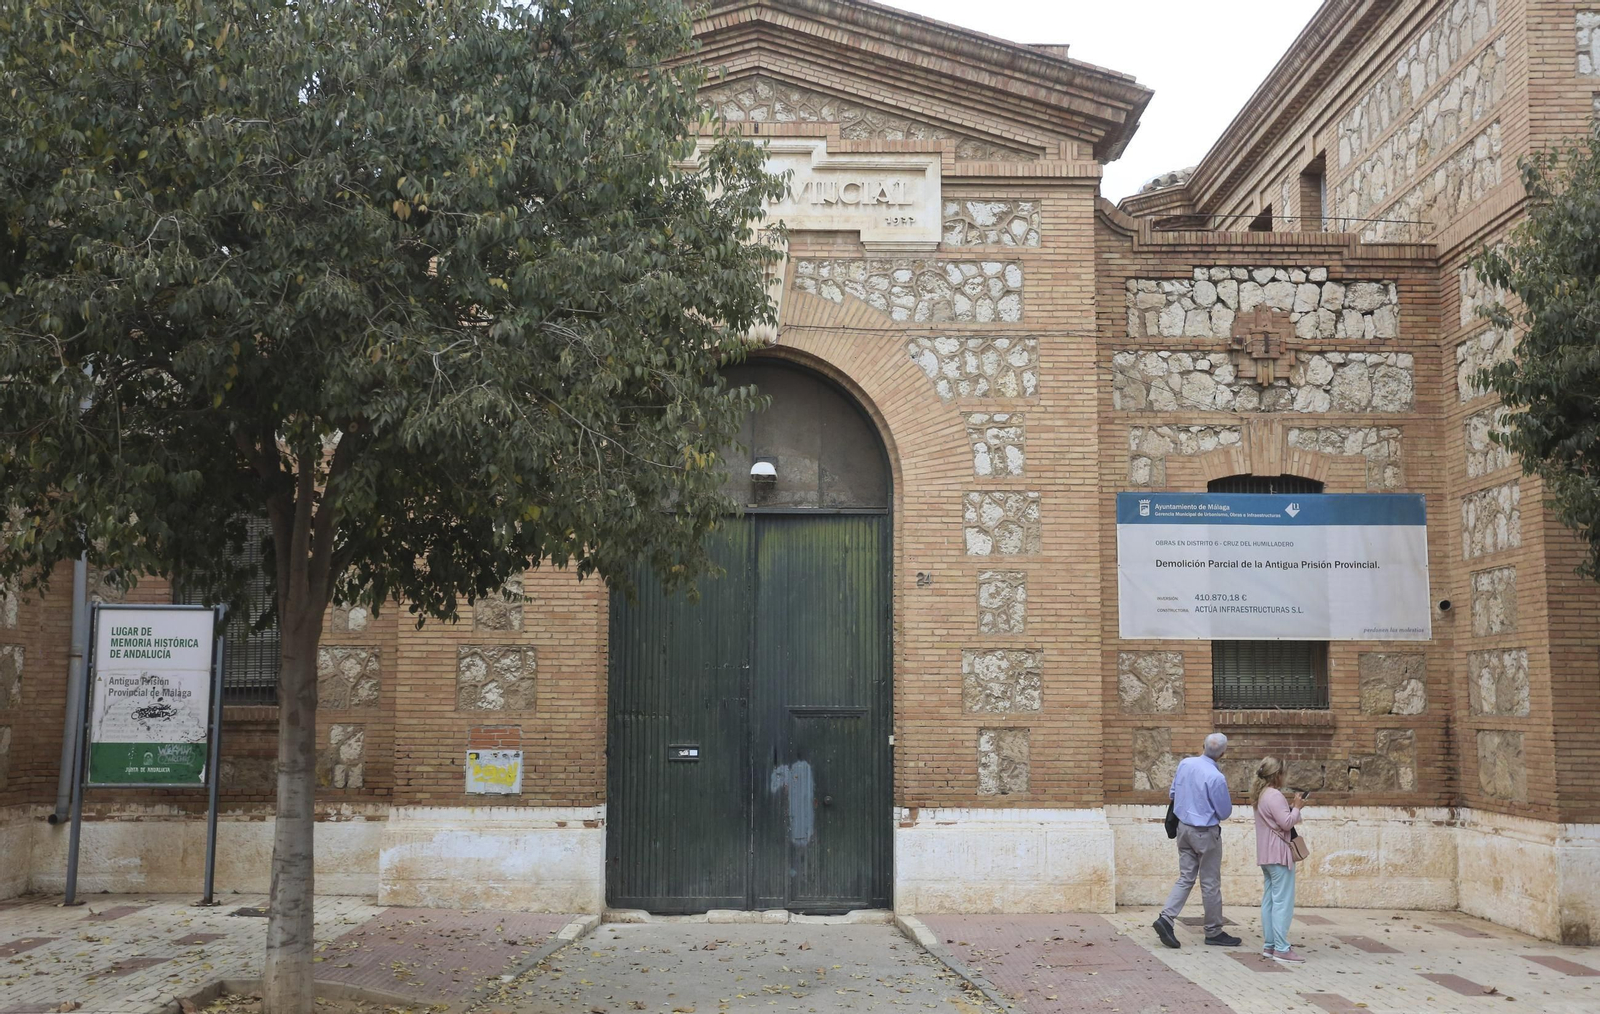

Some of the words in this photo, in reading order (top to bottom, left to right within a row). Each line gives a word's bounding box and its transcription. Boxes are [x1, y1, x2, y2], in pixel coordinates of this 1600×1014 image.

[1154, 503, 1197, 511] Ayuntamiento
[1207, 503, 1230, 511] Málaga
[1155, 559, 1206, 568] Demolición
[1208, 559, 1239, 568] Parcial
[1241, 560, 1252, 568] de
[1254, 560, 1263, 568] la
[1265, 560, 1299, 570] Antigua
[1301, 560, 1332, 569] Prisión
[1334, 560, 1380, 569] Provincial.
[916, 571, 932, 587] 24
[1194, 604, 1218, 613] ACTÚA
[1219, 605, 1290, 613] INFRAESTRUCTURAS
[1291, 606, 1304, 614] S.L.
[111, 627, 139, 636] LUGAR
[141, 627, 152, 636] DE
[110, 638, 151, 648] MEMORIA
[154, 636, 199, 648] HISTÓRICA
[109, 649, 121, 658] DE
[123, 647, 171, 659] ANDALUCÍA
[108, 676, 139, 687] Antigua
[141, 676, 170, 686] Prisión
[108, 687, 148, 697] Provincial
[150, 687, 160, 697] de
[162, 688, 192, 698] Málaga
